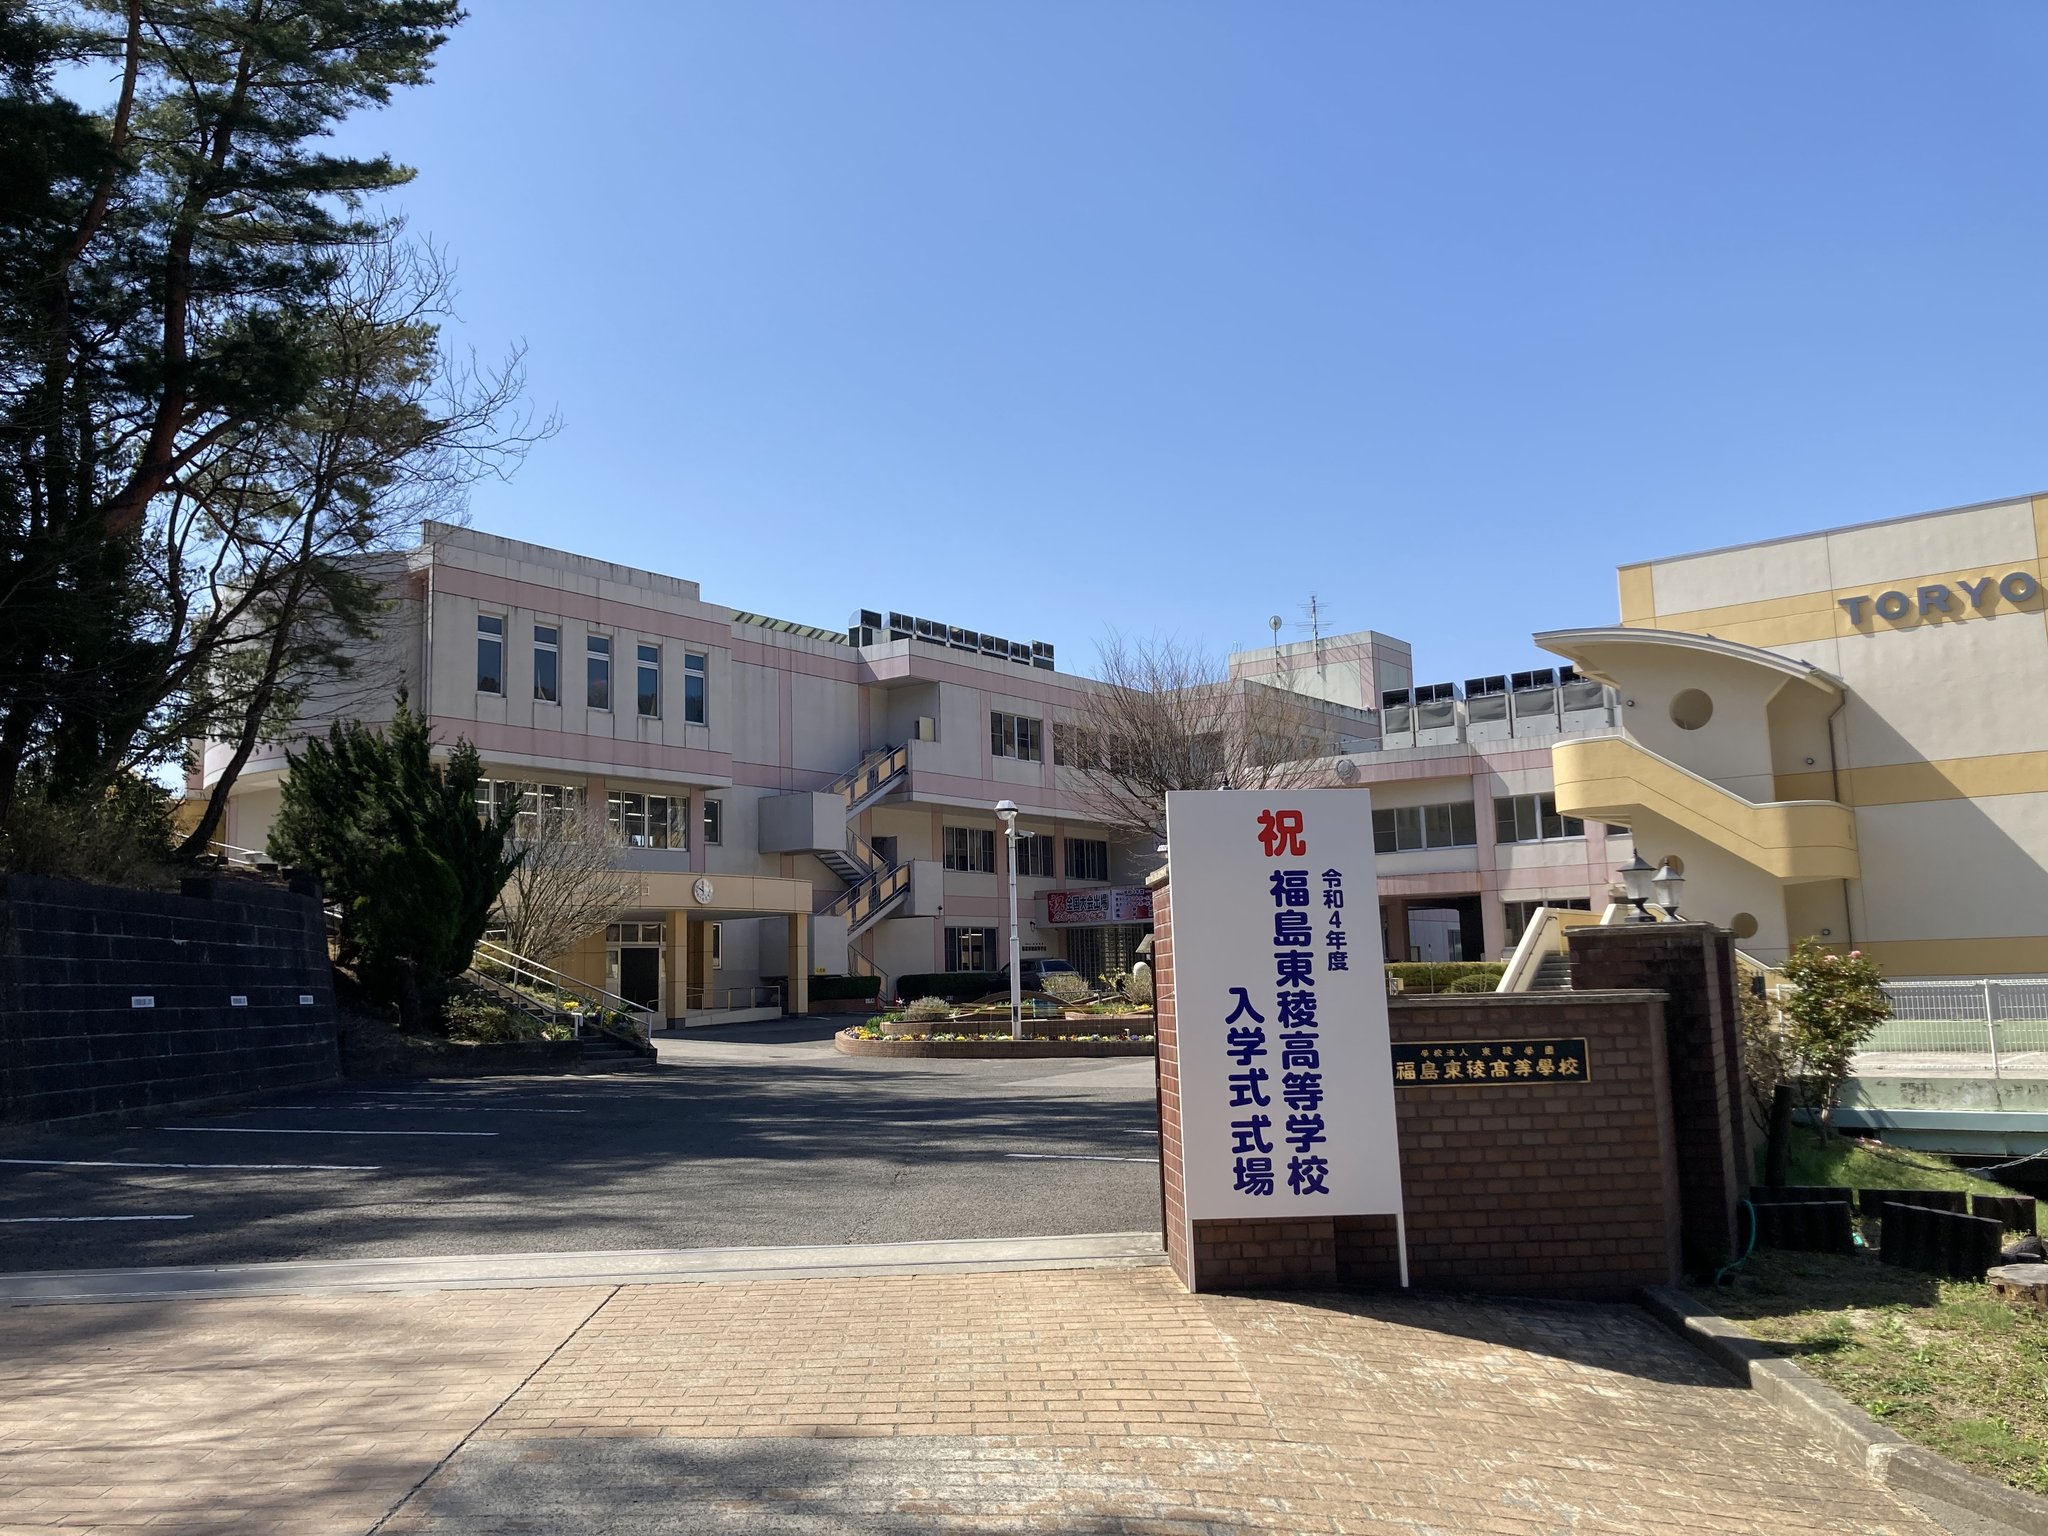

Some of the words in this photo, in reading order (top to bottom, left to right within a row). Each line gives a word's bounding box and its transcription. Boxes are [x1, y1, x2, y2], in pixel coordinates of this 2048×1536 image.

[1838, 572, 2036, 624] TORYO
[1257, 809, 1307, 857] 祝
[1066, 893, 1109, 911] 全国大会出場
[1321, 869, 1349, 971] 令和4年度
[1269, 869, 1330, 1195] 福島東稜高等学校
[1225, 987, 1275, 1196] 入学式式場
